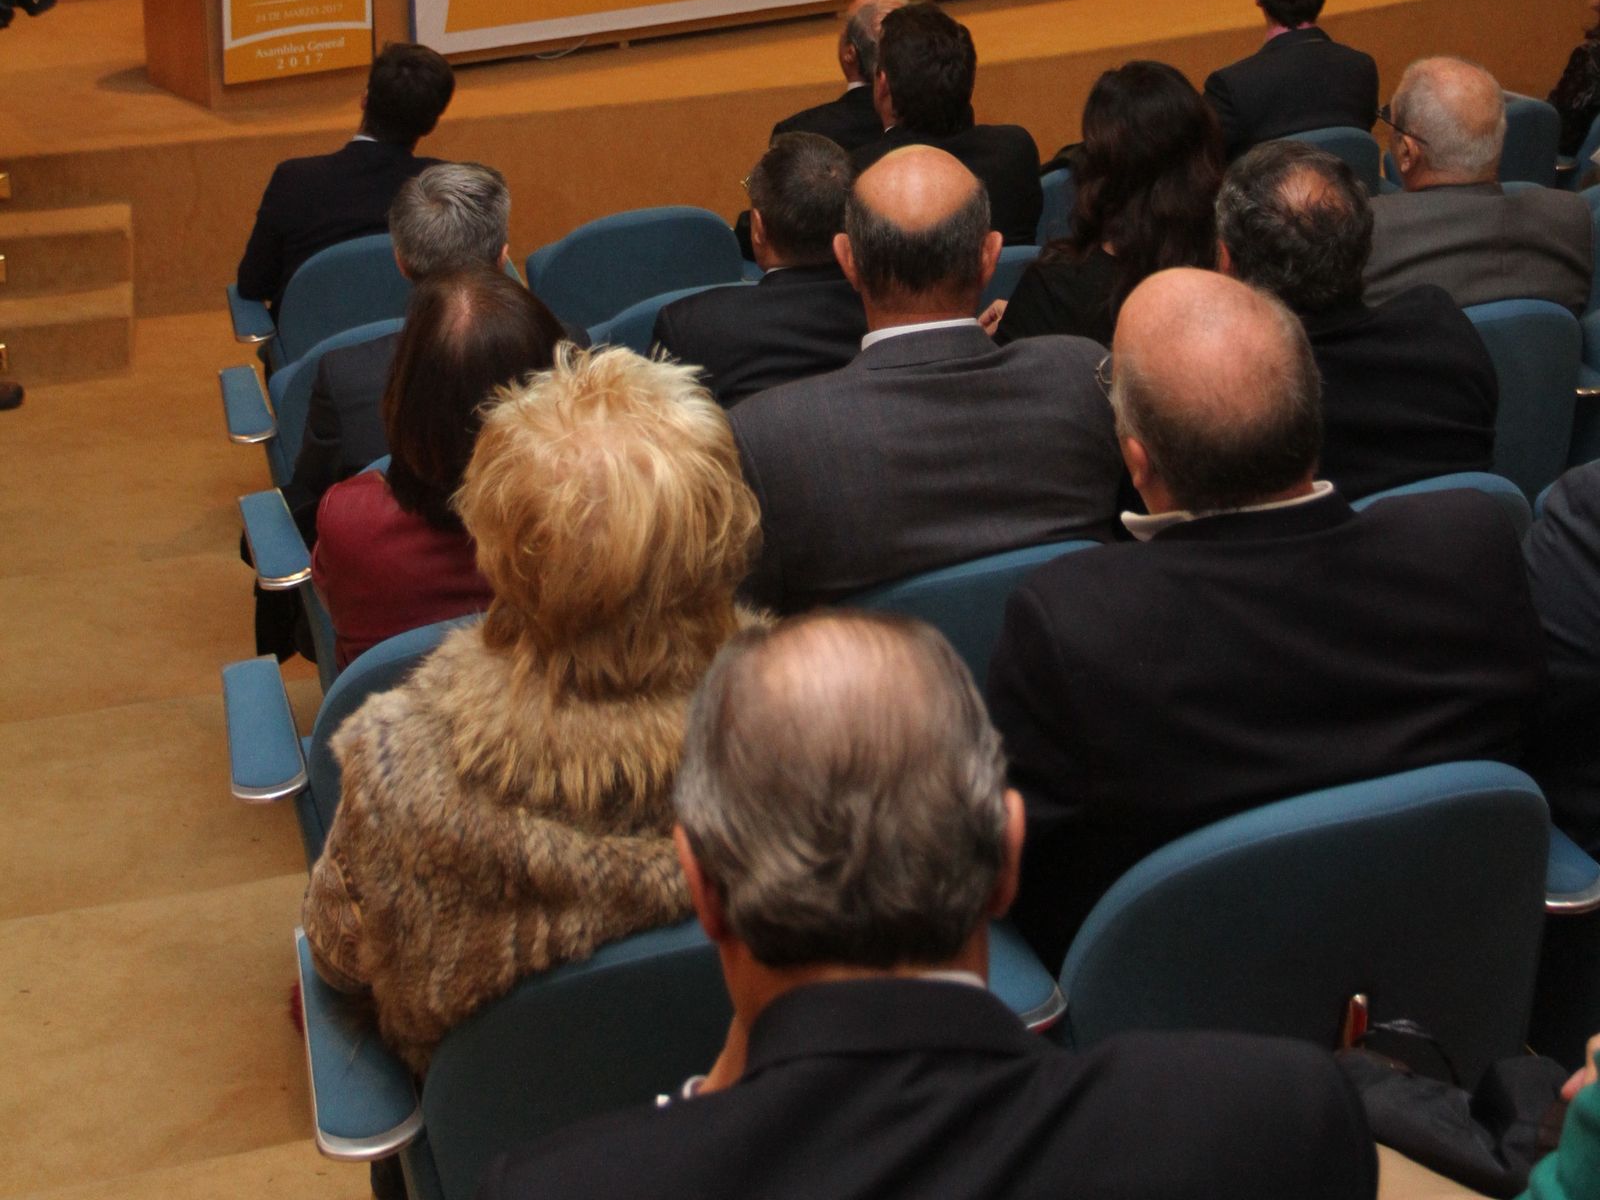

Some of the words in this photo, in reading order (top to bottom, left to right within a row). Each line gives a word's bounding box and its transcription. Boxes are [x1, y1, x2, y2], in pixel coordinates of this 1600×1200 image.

[283, 6, 320, 20] MARZO
[255, 43, 304, 59] Asamblea
[307, 36, 346, 53] General
